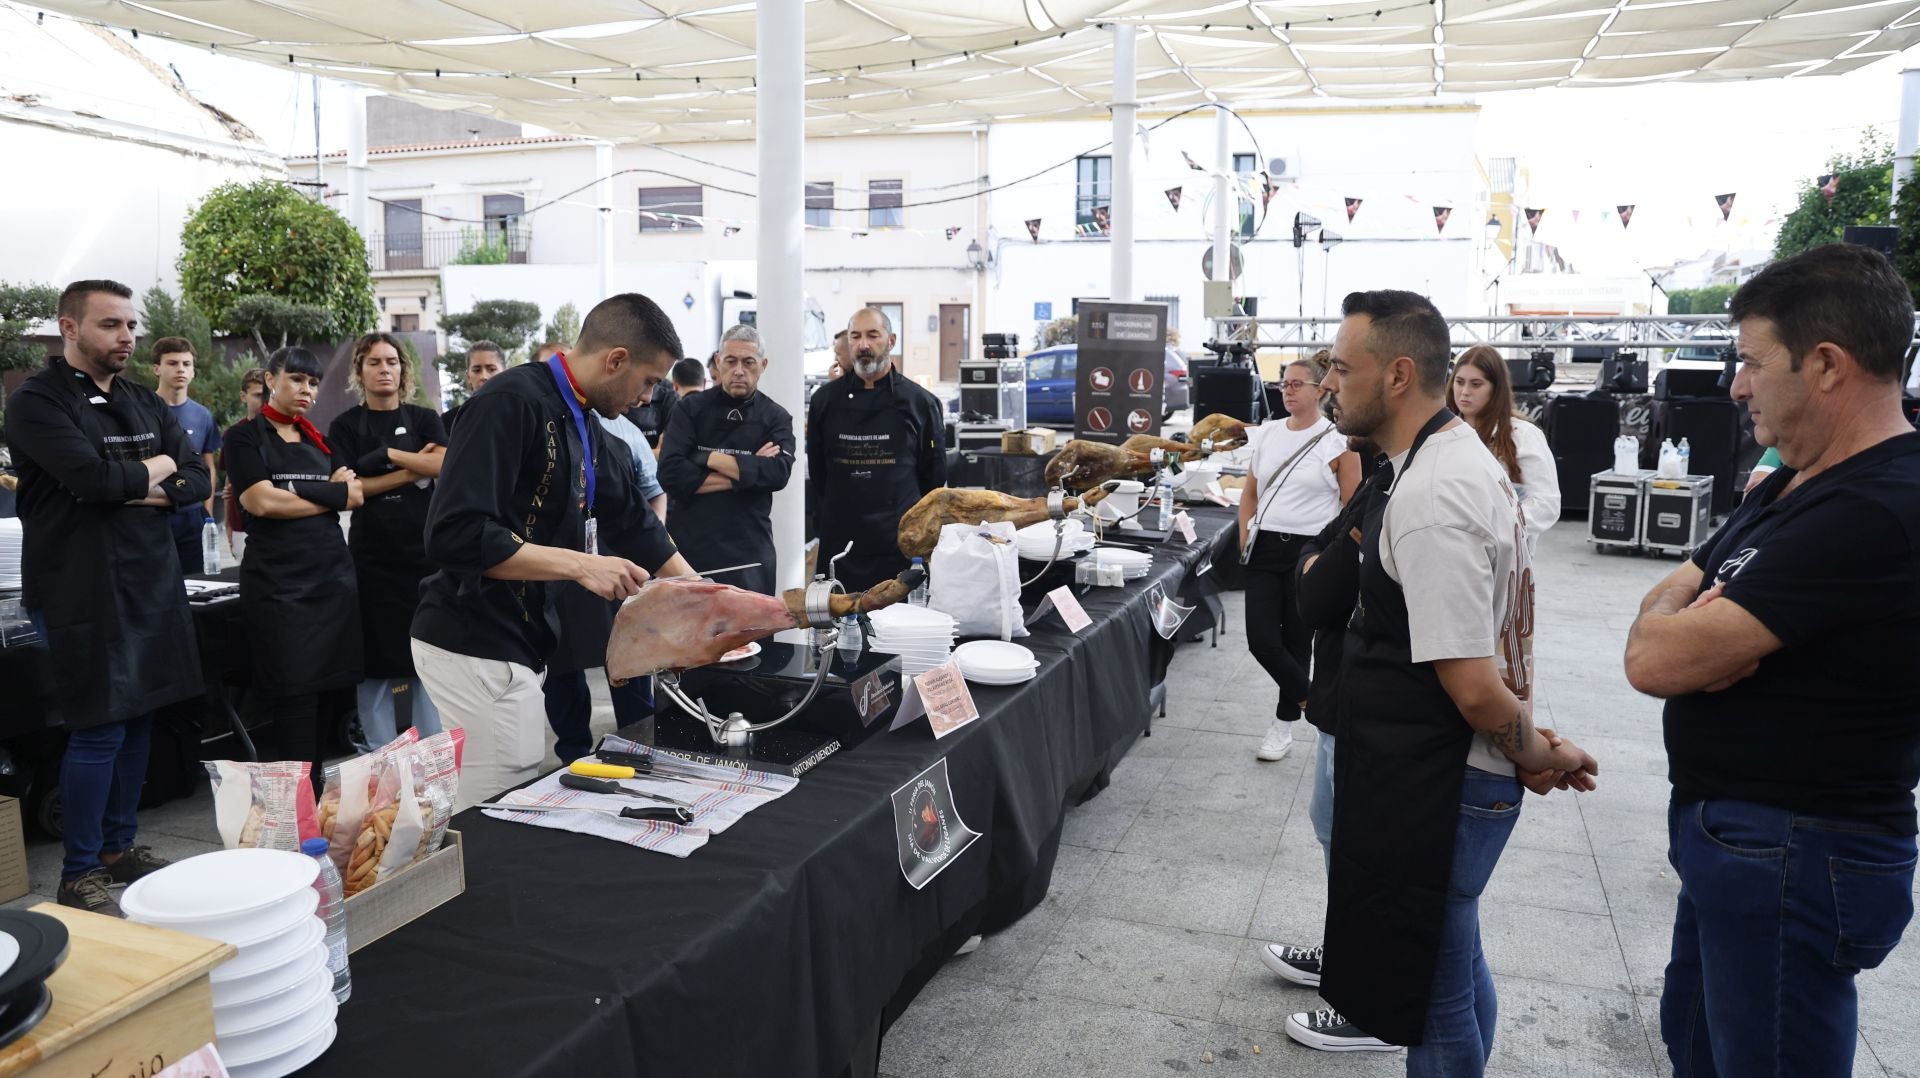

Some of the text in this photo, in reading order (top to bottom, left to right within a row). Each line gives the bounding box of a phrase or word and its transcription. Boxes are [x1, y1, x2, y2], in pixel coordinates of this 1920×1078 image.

[696, 756, 711, 764] DE
[715, 758, 748, 770] JAMÓN
[792, 740, 842, 778] ANTONIO MENDOZA
